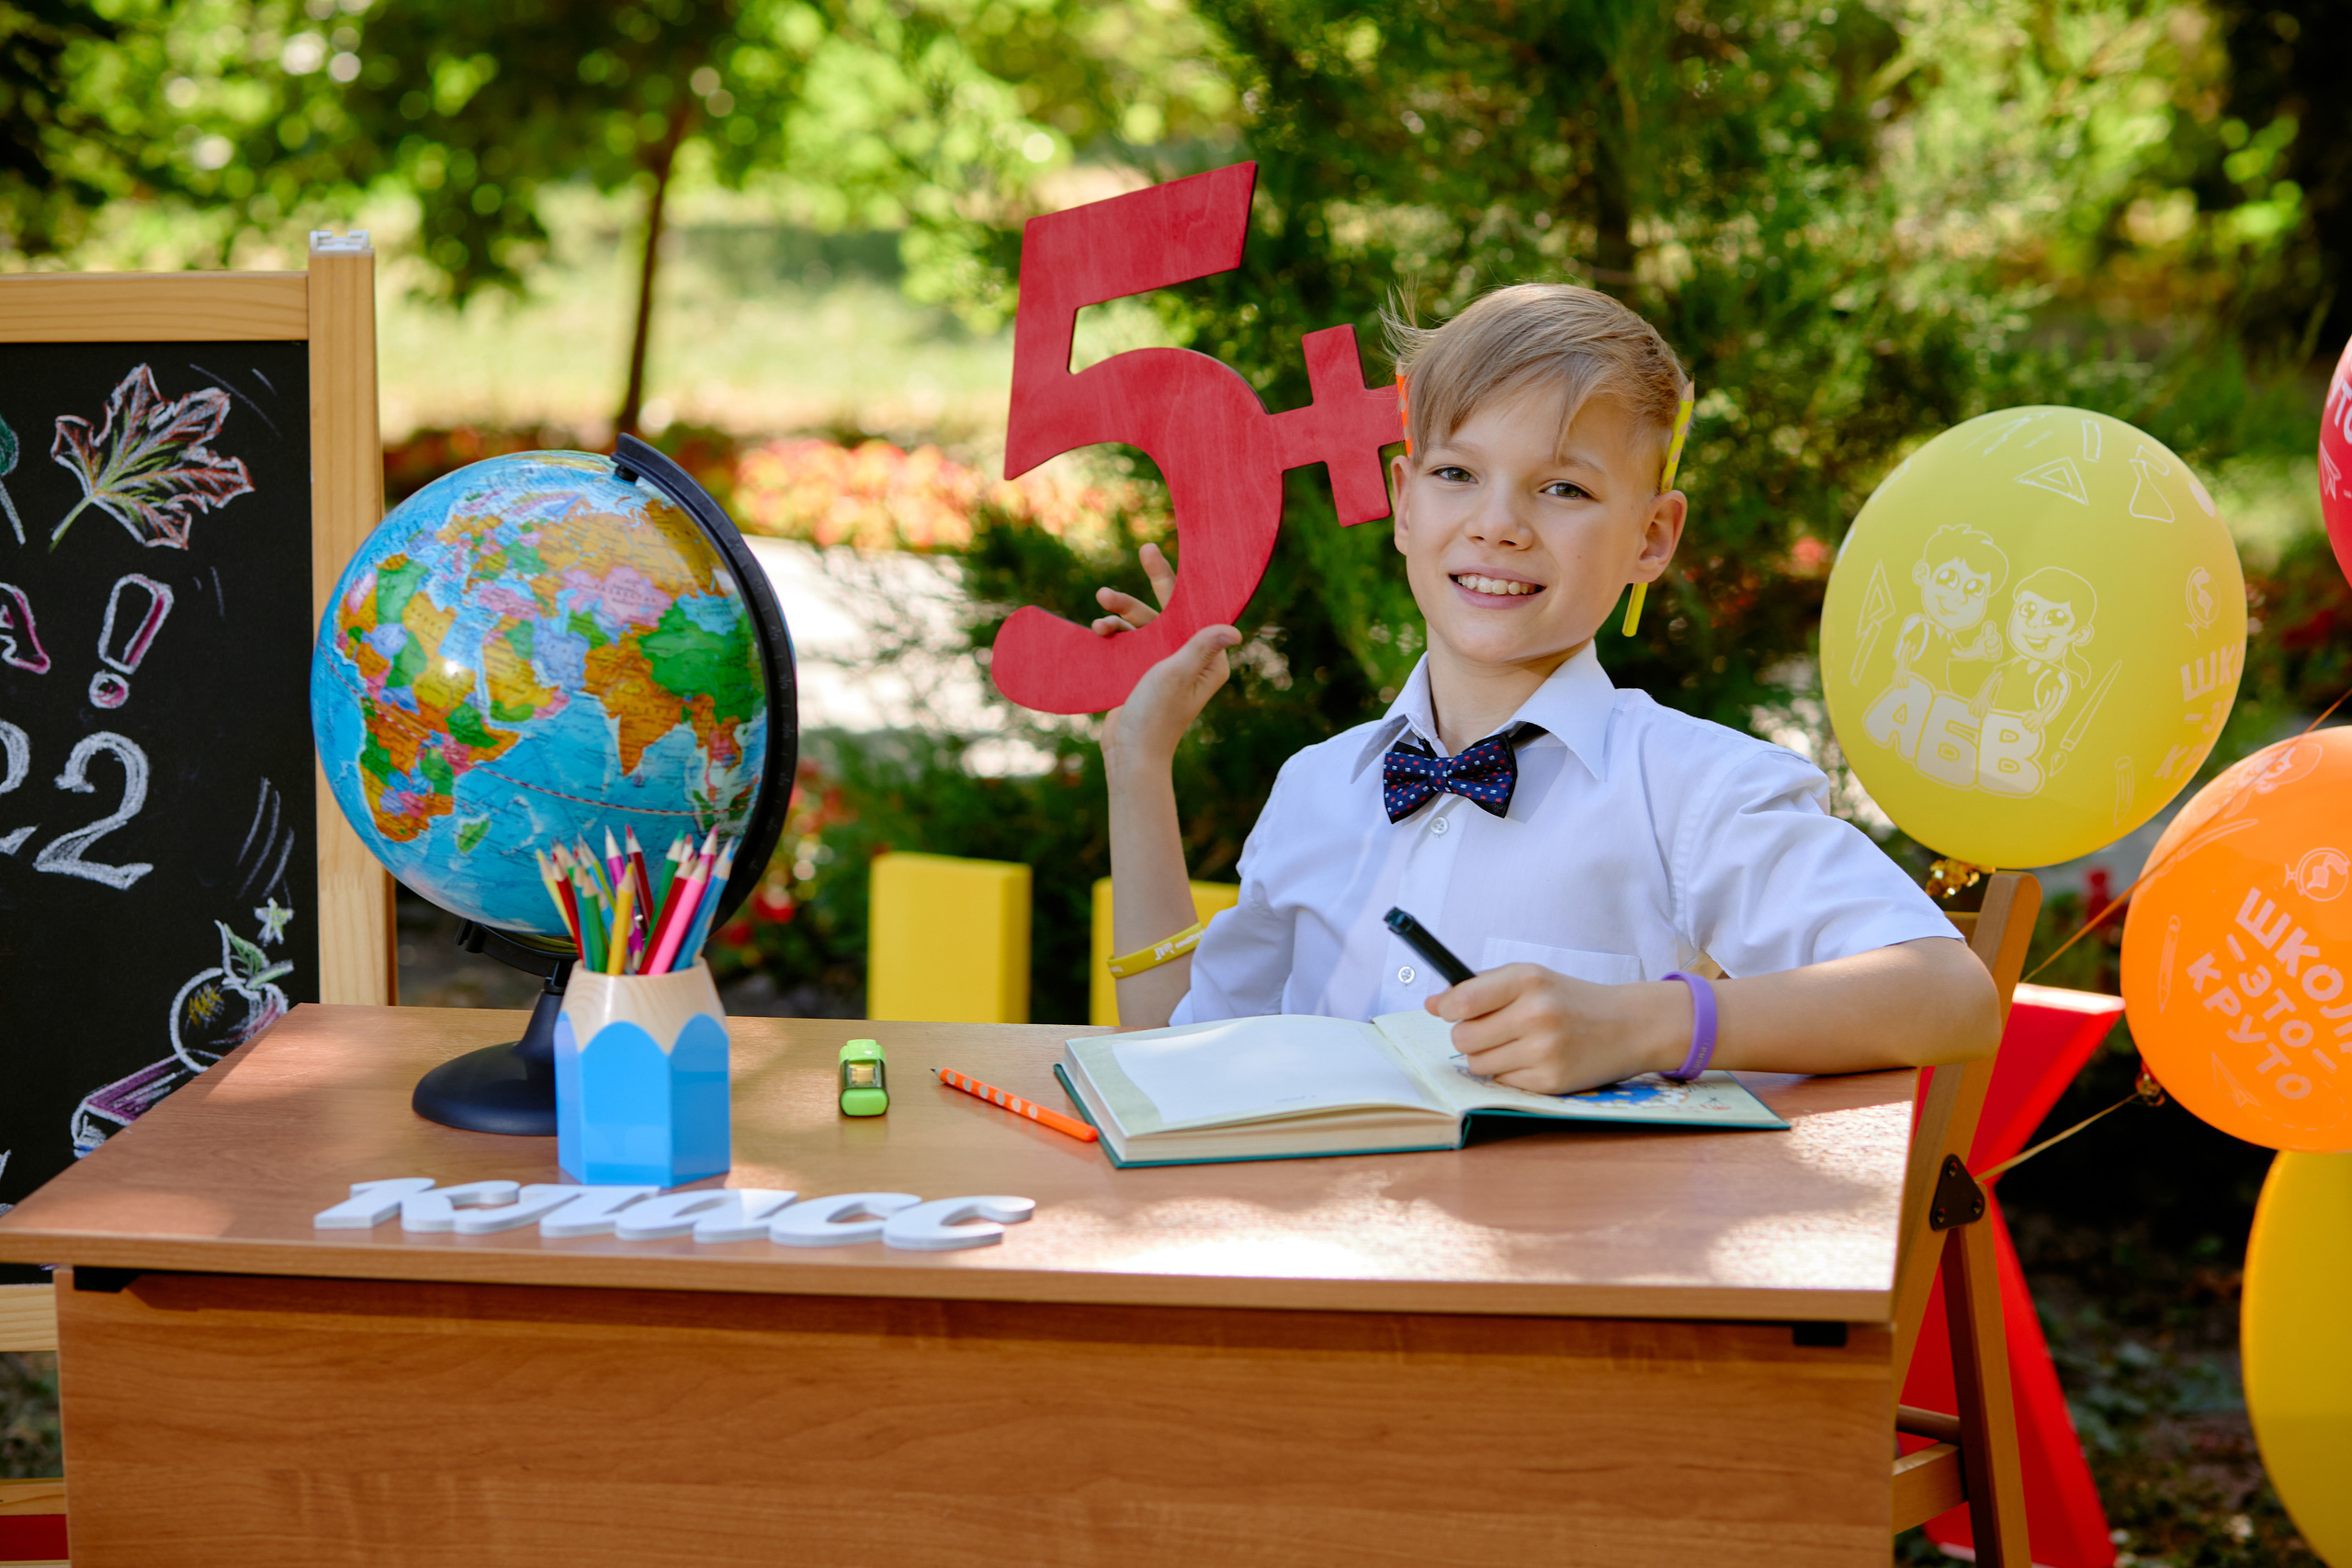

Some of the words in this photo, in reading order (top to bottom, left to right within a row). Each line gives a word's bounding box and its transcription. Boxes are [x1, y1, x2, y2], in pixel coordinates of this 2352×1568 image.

[991, 160, 1407, 716] 5+
[1861, 671, 2046, 799] АБВ
[2186, 952, 2312, 1100] КРУТО
[2234, 886, 2352, 1055] ШКОЛ
